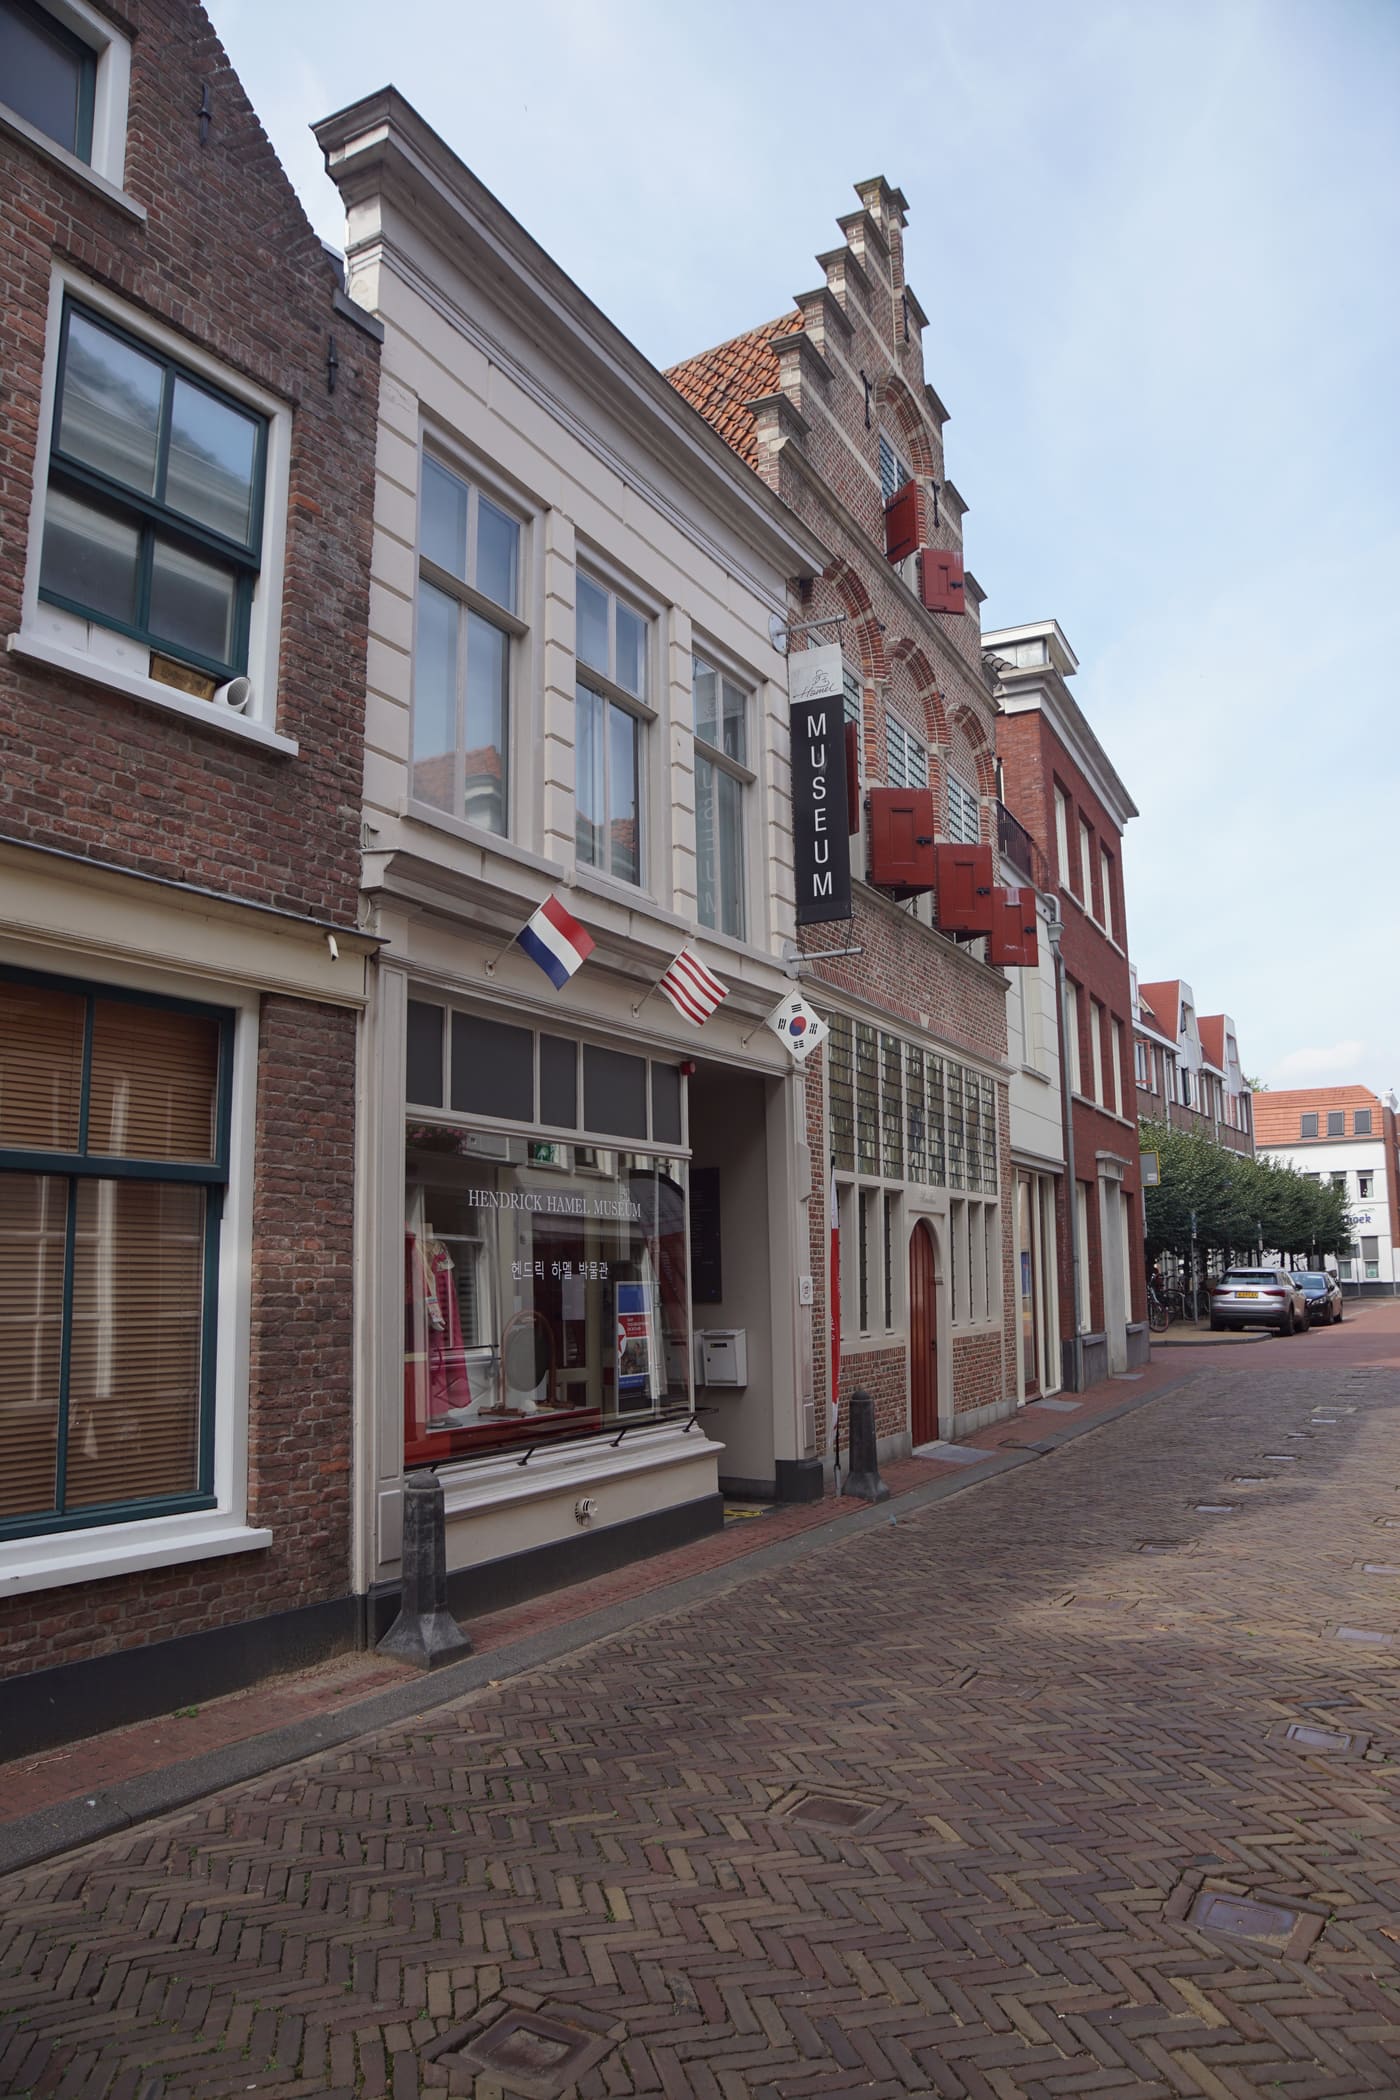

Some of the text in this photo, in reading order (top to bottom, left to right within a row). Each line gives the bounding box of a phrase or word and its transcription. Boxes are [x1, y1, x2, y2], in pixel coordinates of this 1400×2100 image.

[807, 712, 833, 897] MUSEUM
[468, 1189, 641, 1218] HENDRICK HAMEL MUSEUM
[511, 1260, 609, 1281] 헨드릭 하멜 박물관
